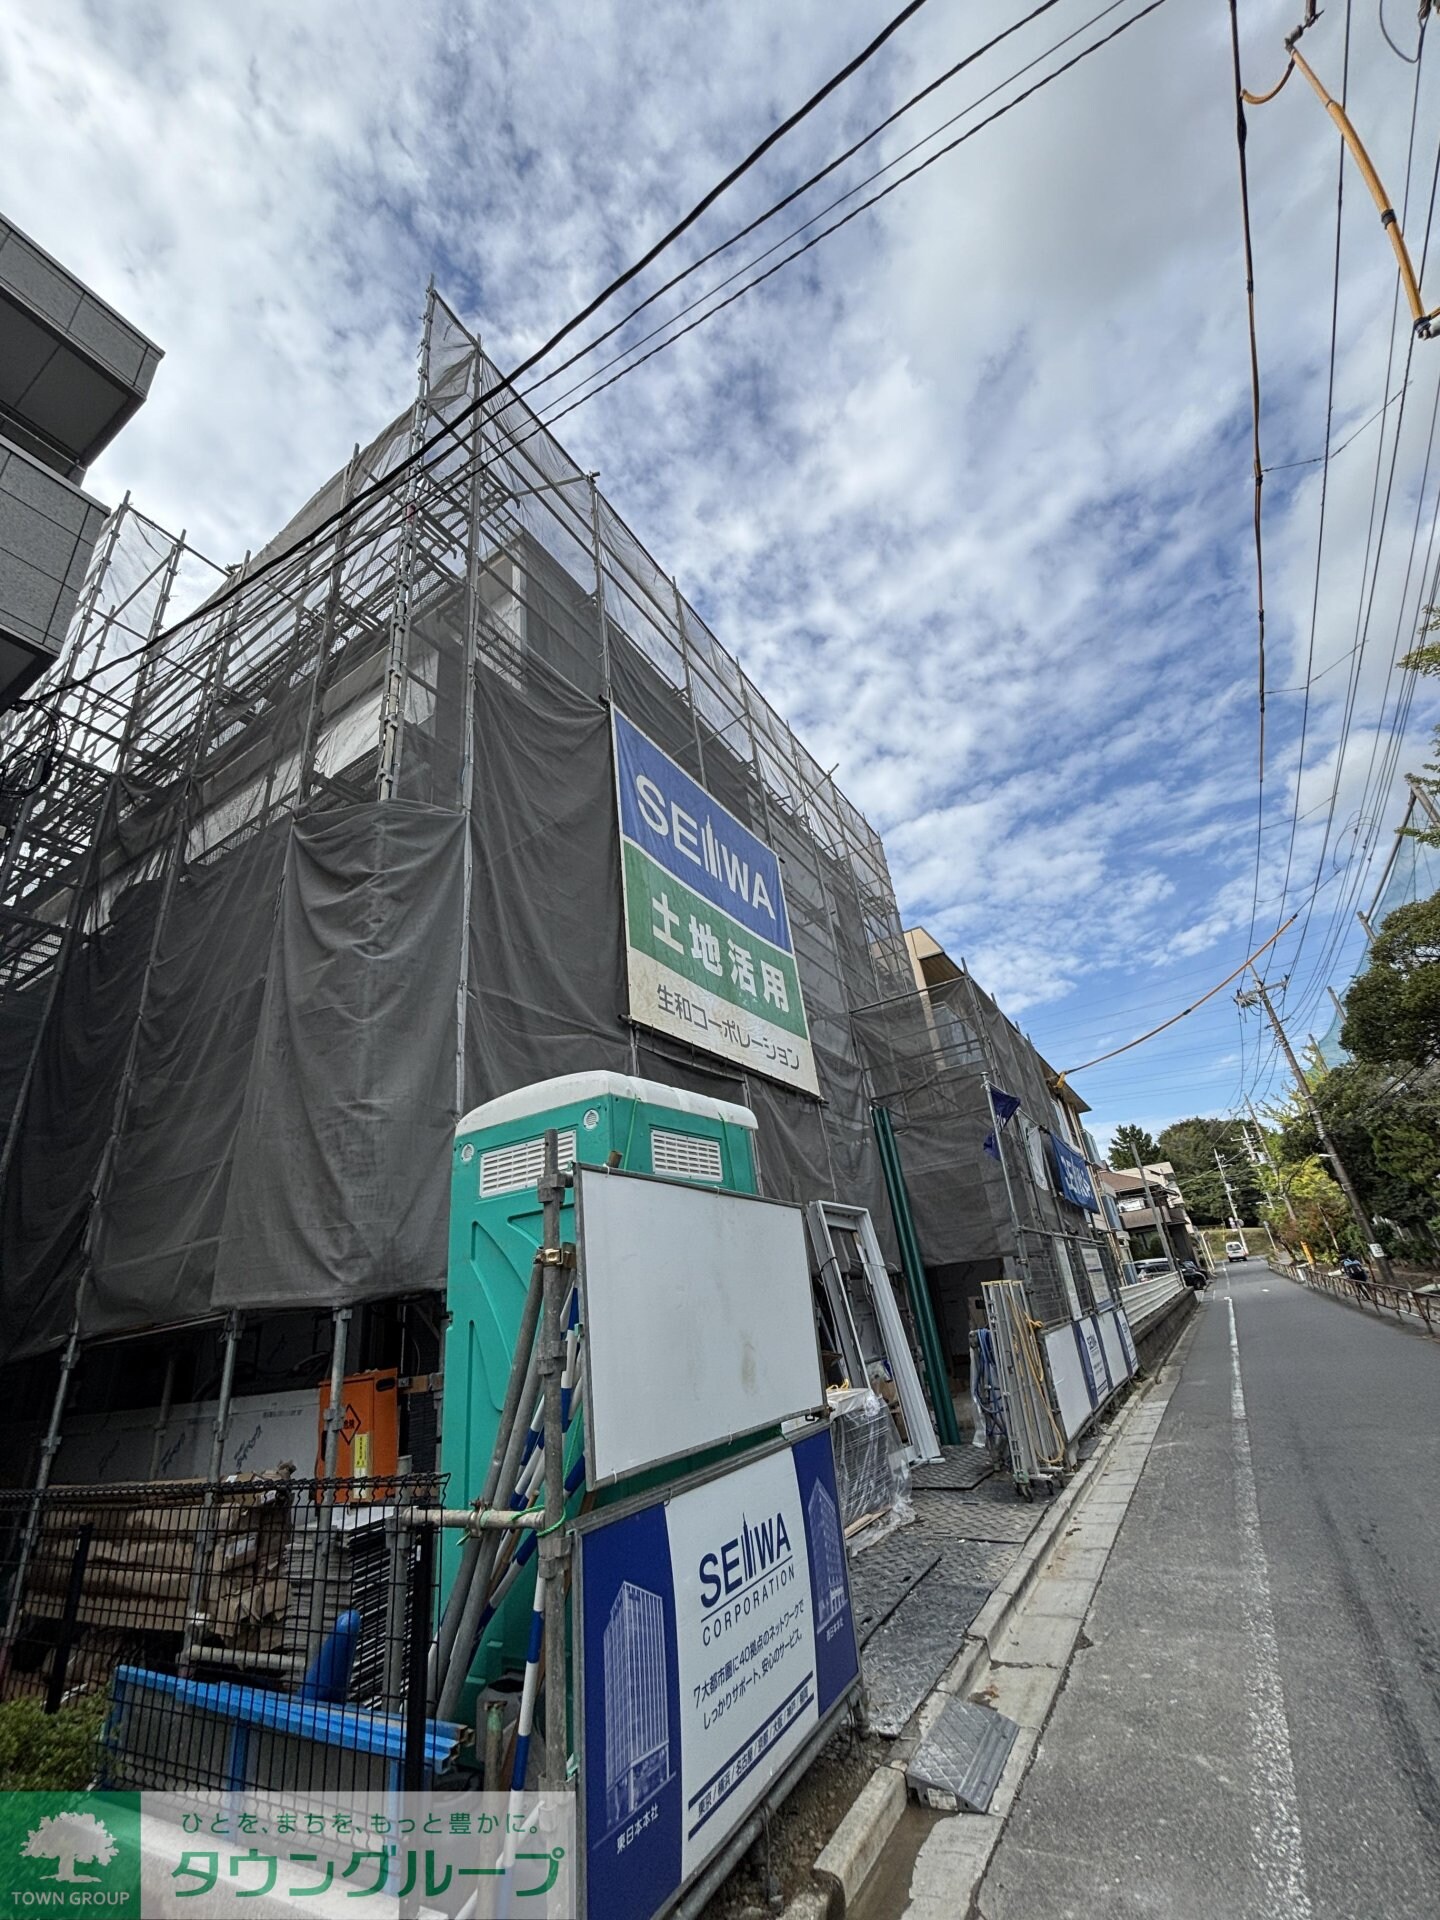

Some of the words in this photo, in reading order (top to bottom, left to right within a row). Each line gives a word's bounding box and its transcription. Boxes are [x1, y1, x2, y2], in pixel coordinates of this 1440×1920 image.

[651, 892, 789, 1013] 土地活用
[657, 983, 800, 1071] 生和コーポレーション
[702, 1564, 795, 1647] CORPORATION
[616, 1803, 659, 1855] 東日本本社
